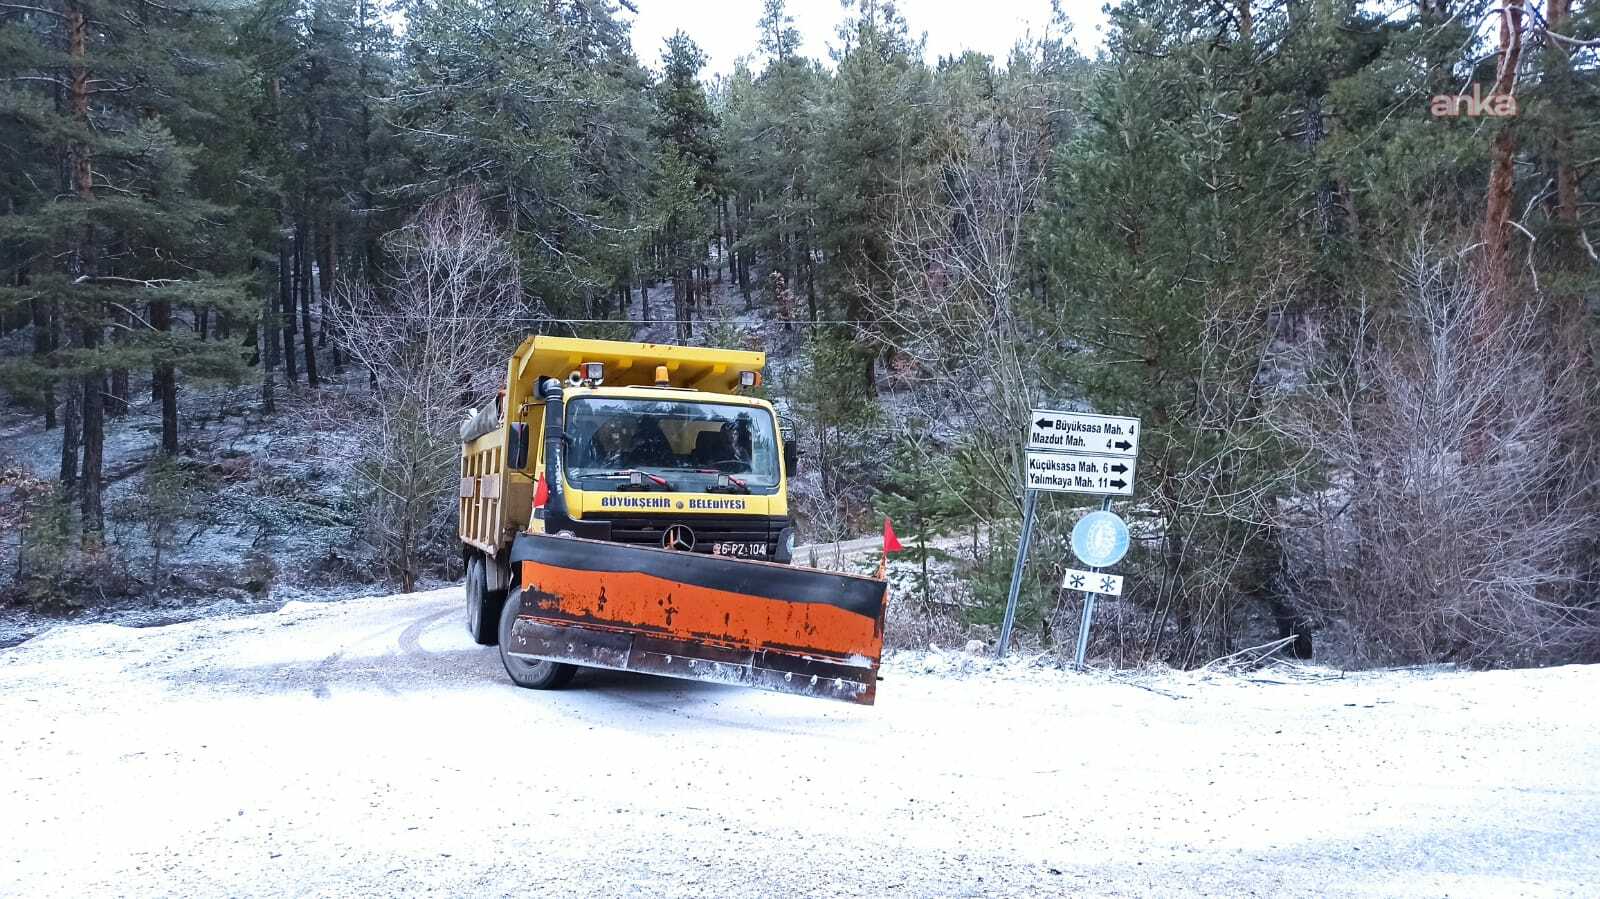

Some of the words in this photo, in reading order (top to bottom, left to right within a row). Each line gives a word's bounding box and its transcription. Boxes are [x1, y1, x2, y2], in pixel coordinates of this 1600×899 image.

[1055, 419, 1102, 433] Büyüksasa
[1103, 423, 1124, 435] Mah.
[1128, 424, 1135, 435] 4
[1032, 432, 1063, 444] Mazdut
[1065, 435, 1086, 447] Mah.
[1106, 439, 1112, 449] 4
[1029, 458, 1076, 472] Küçüksasa
[1078, 461, 1099, 473] Mah.
[1103, 463, 1109, 473] 6
[1030, 473, 1072, 488] Yalımkaya
[1074, 476, 1095, 488] Mah.
[1098, 477, 1108, 488] 11
[601, 495, 671, 509] BÜYÜKŞEHİR
[689, 497, 745, 509] BELEDİYESİ
